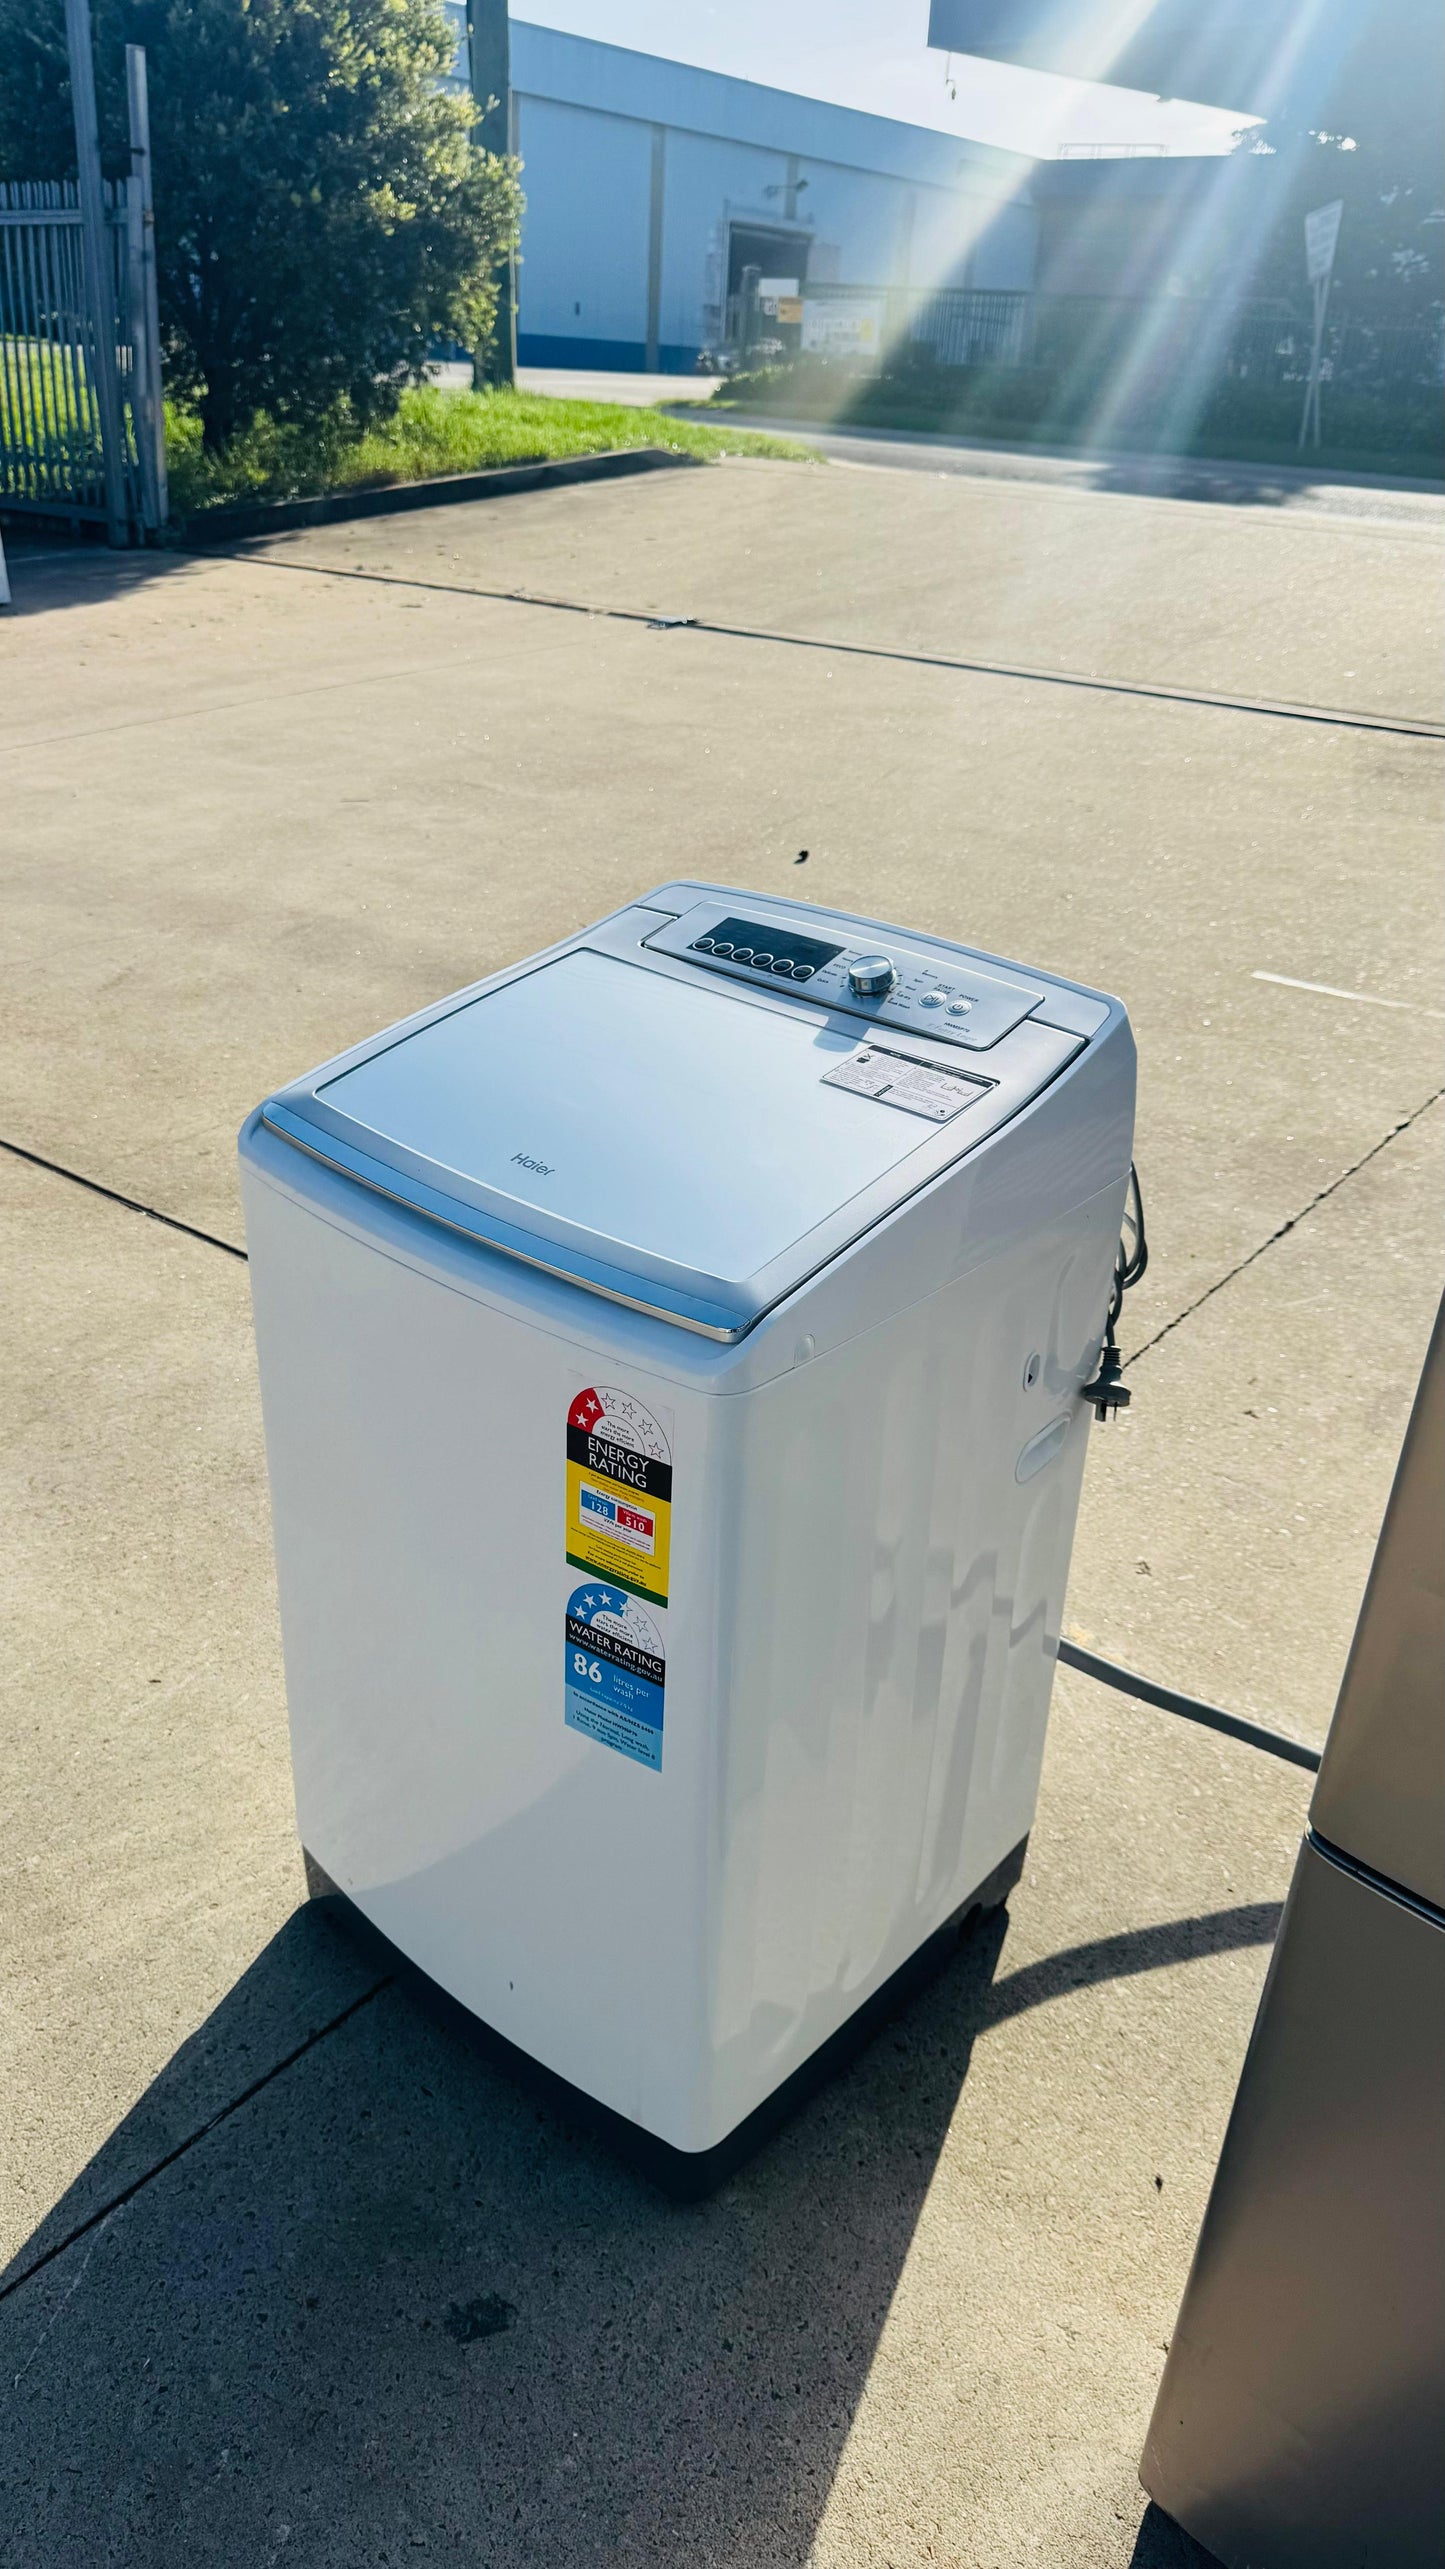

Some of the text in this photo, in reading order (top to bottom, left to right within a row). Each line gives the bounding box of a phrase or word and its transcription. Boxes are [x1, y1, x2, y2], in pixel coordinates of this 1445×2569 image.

[959, 994, 980, 1002] POWER
[510, 1153, 555, 1176] Haier
[600, 1431, 616, 1441] energy
[617, 1426, 629, 1434] more
[622, 1434, 634, 1442] more
[588, 1436, 649, 1473] ENERGY
[588, 1454, 647, 1488] RATING
[596, 1490, 611, 1500] Energy
[591, 1501, 609, 1516] 128
[625, 1516, 645, 1532] 510
[596, 1618, 609, 1627] stars
[619, 1629, 633, 1639] more
[602, 1614, 627, 1630] The more
[596, 1624, 633, 1644] water efficient
[569, 1620, 662, 1673] WATER RATING
[568, 1633, 663, 1682] www.waterrating.gov.au
[573, 1653, 602, 1683] 86
[613, 1674, 649, 1699] litres per
[613, 1686, 634, 1700] wash
